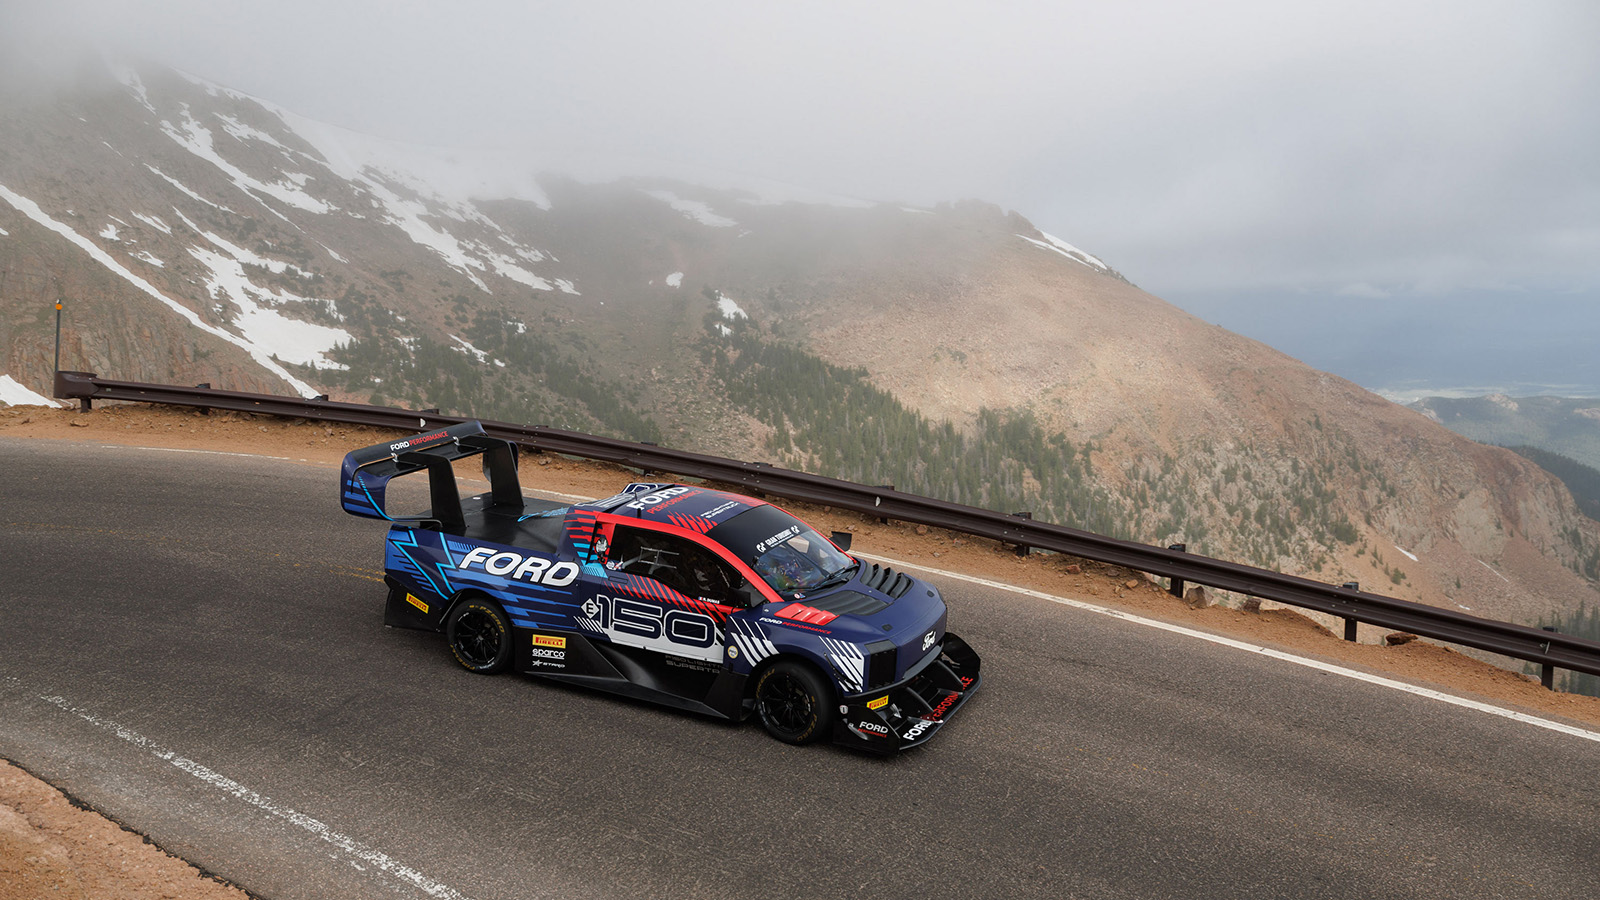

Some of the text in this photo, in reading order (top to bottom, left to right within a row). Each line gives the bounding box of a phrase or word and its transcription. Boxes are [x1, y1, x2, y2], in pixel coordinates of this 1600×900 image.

[390, 431, 449, 451] FORD PERFORMANCE
[626, 487, 689, 510] FORD
[646, 490, 705, 514] PERFORMANCE
[459, 547, 580, 587] FORD
[408, 595, 428, 612] PIRELLI
[586, 594, 716, 649] E 150
[759, 617, 832, 634] FORD PERFORMANCE
[535, 637, 564, 646] PIRELLI
[922, 630, 936, 651] Ford
[532, 648, 565, 658] sparco
[869, 697, 887, 709] PIRELLI
[859, 721, 888, 733] FORD
